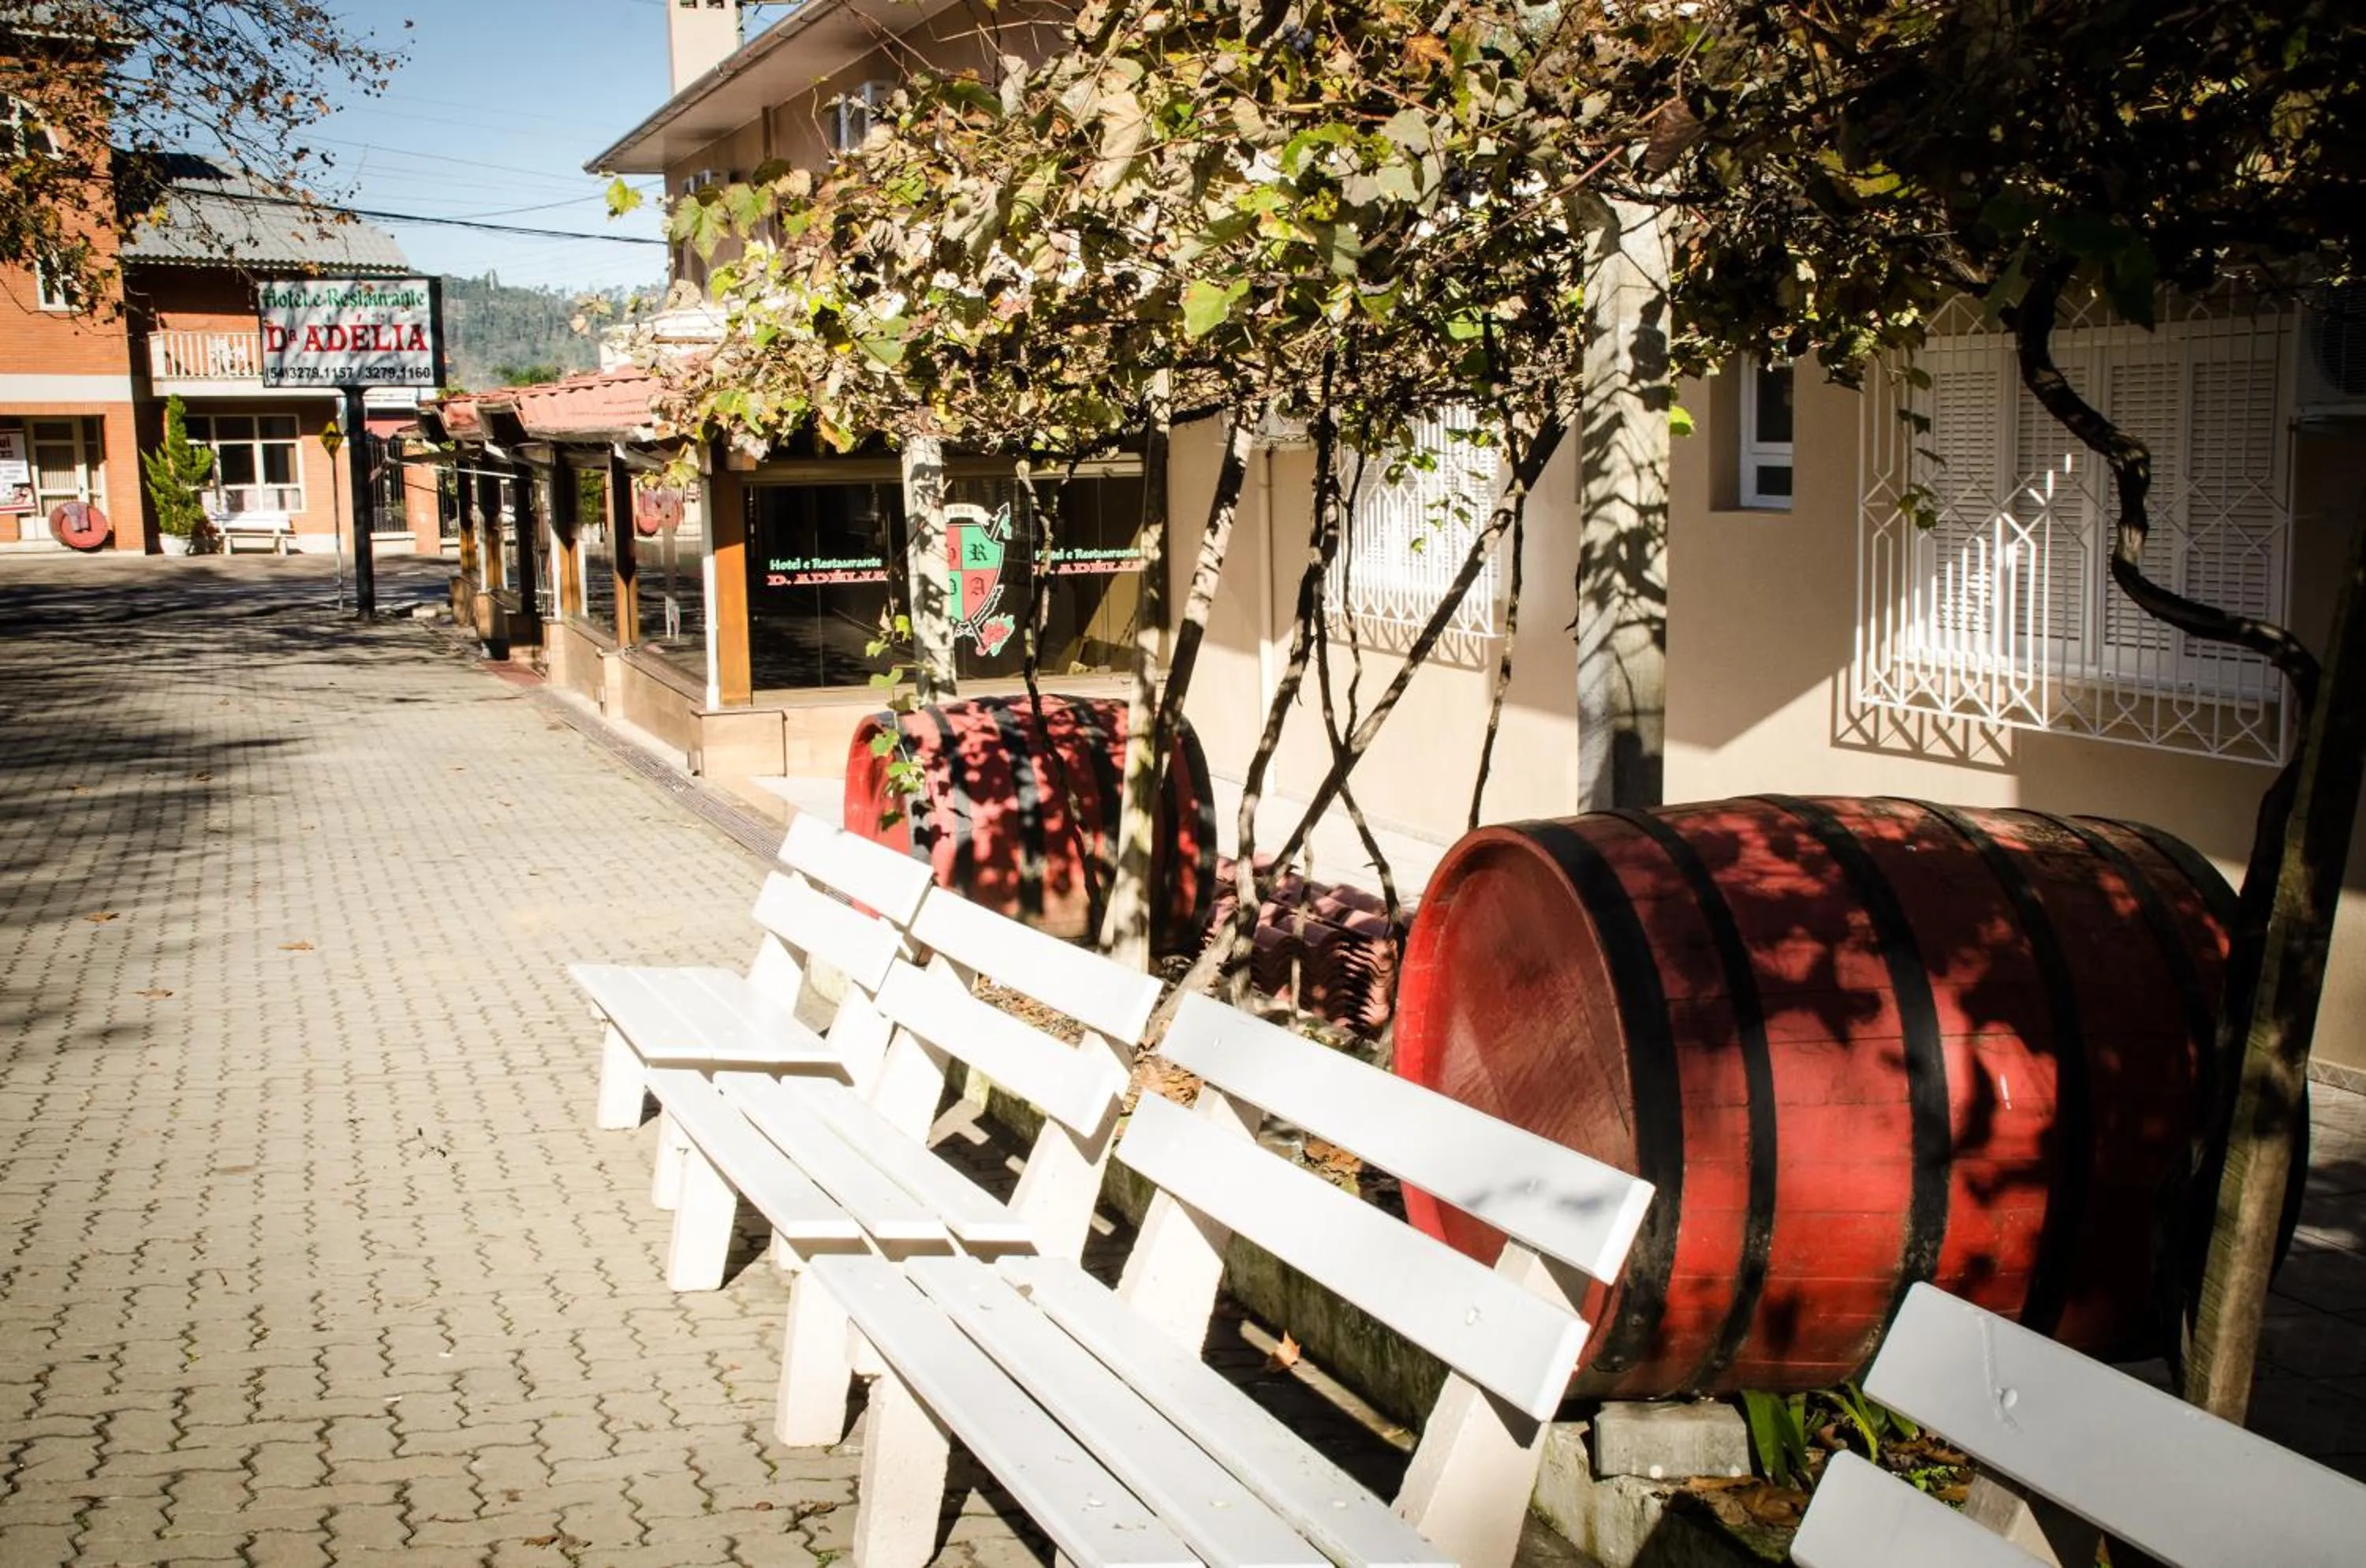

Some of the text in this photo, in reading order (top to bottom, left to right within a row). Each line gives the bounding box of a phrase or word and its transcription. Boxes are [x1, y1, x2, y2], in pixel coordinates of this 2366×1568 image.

[261, 288, 308, 308] Hotel
[313, 293, 323, 307] e
[303, 314, 428, 352] ADÉLIA
[365, 367, 431, 379] 3279.1160
[769, 557, 801, 570] Hotel
[811, 557, 883, 569] Restaurante
[766, 574, 792, 586] D.
